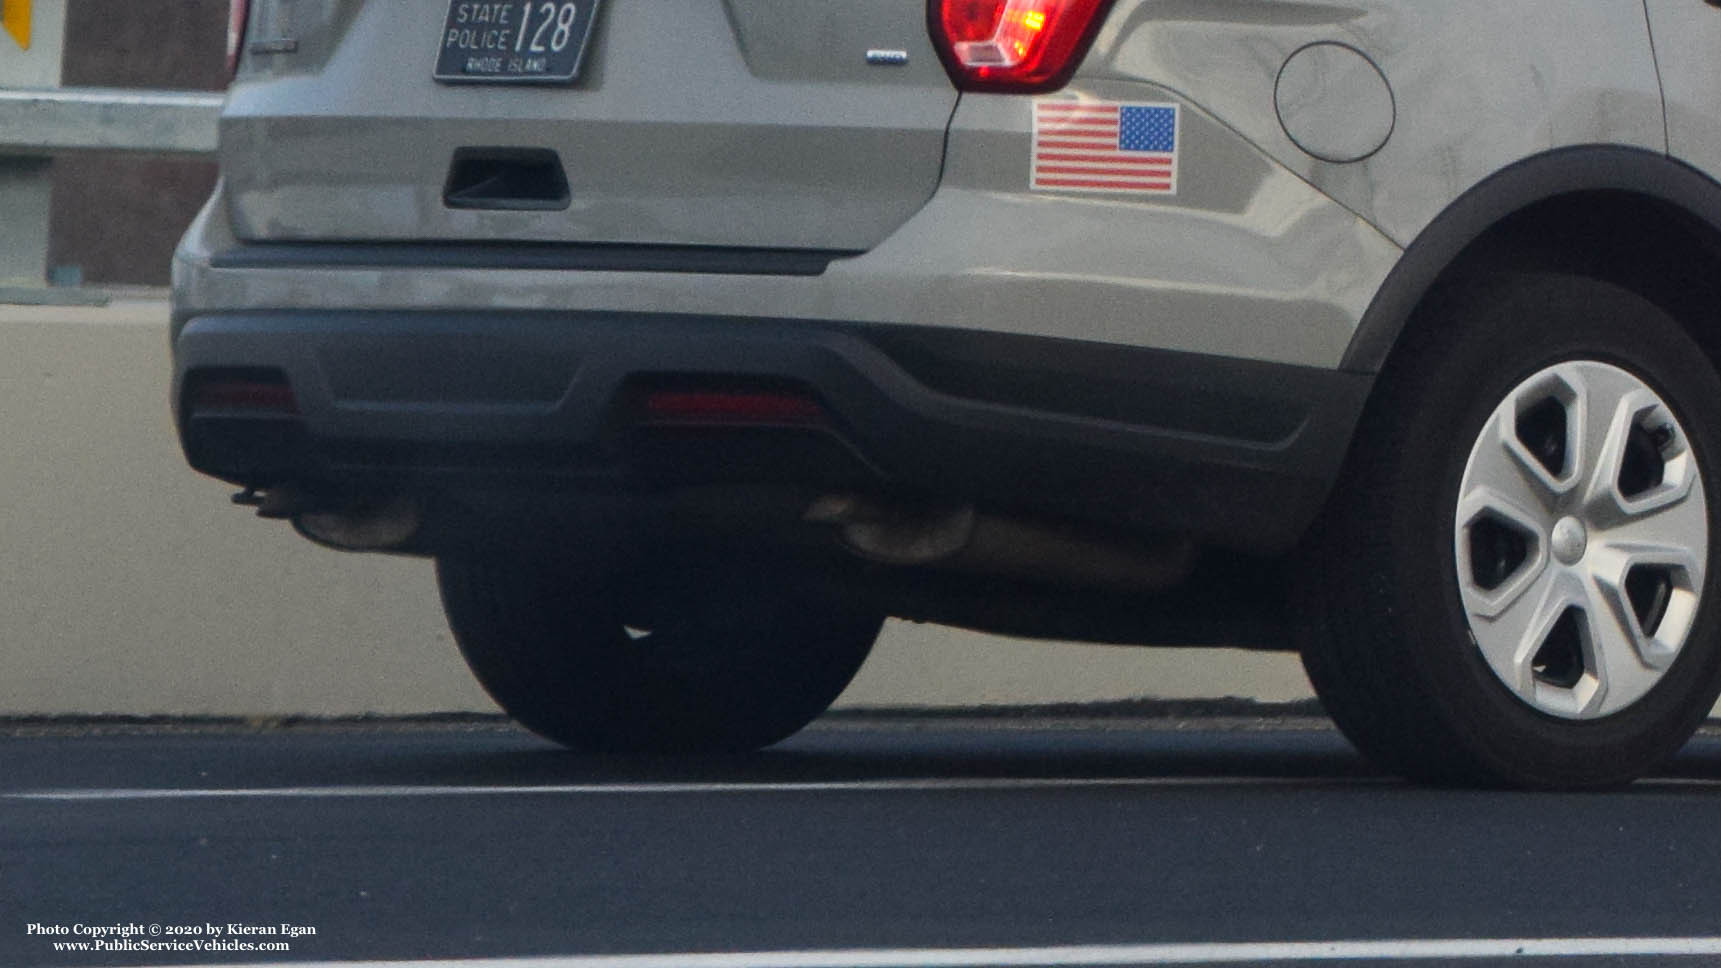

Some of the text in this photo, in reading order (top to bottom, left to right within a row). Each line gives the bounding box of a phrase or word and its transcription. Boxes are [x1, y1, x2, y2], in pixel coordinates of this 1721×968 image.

[457, 3, 513, 24] STATE
[514, 1, 576, 53] 128
[446, 30, 510, 51] POLICE
[466, 57, 546, 72] RHODE ISLAND
